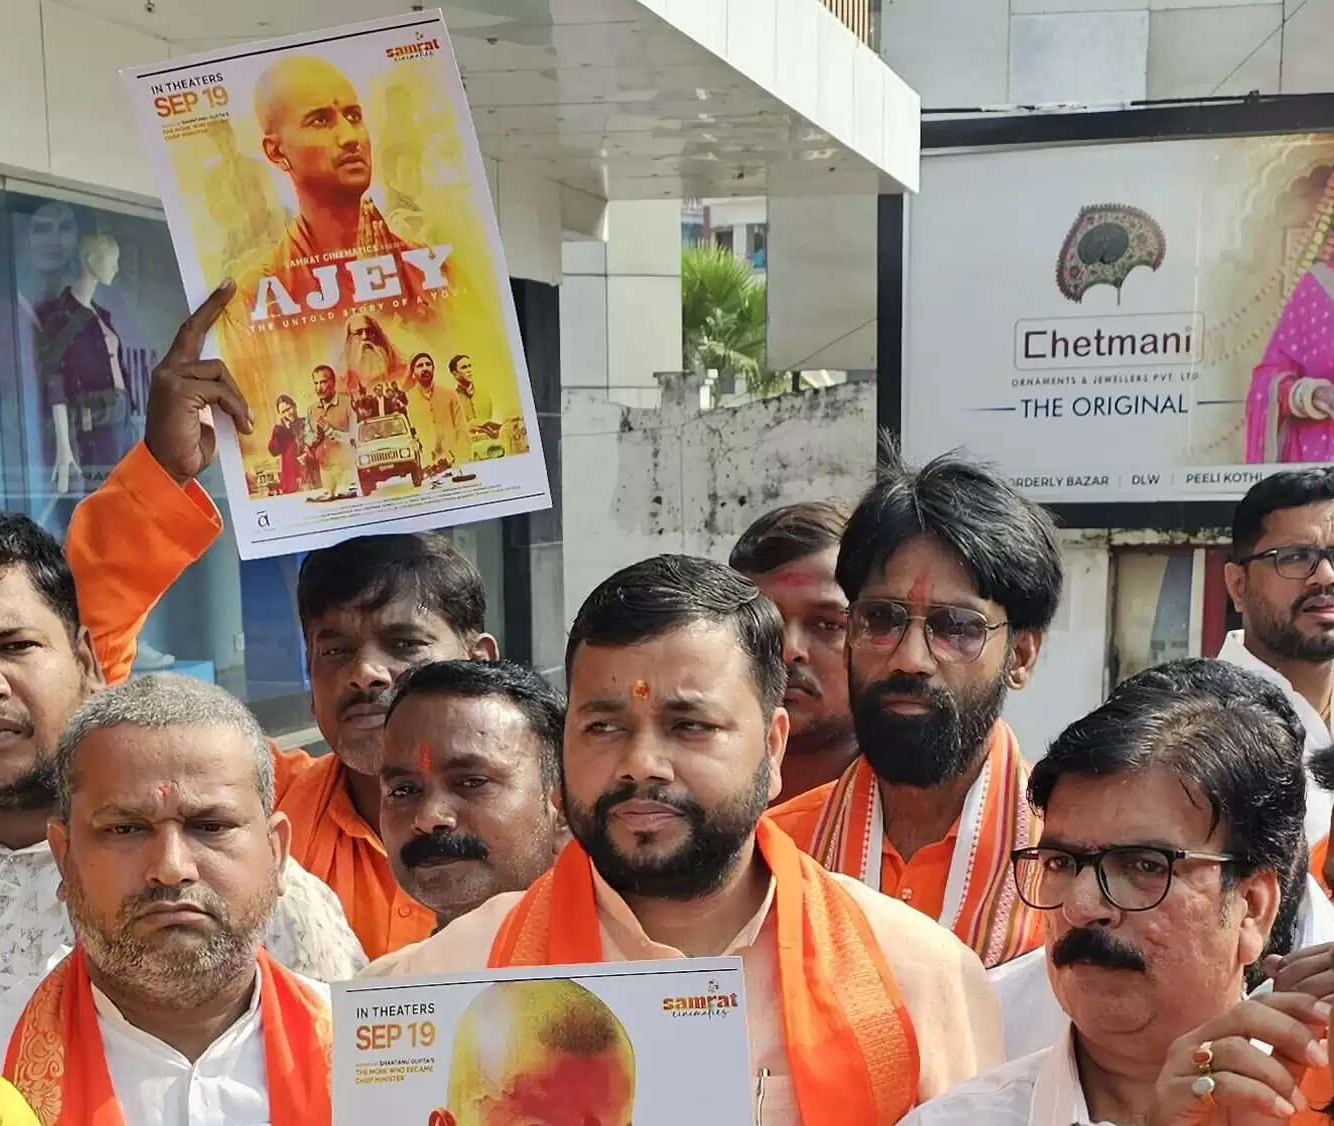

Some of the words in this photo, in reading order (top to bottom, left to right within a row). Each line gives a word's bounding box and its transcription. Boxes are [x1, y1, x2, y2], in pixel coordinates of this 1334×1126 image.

[386, 38, 440, 57] samrat
[151, 85, 163, 95] IN
[165, 73, 224, 92] THEATERS
[154, 91, 198, 118] SEP
[202, 85, 229, 108] 19
[323, 245, 378, 262] CINEMATICS
[251, 244, 453, 321] AJEY
[249, 322, 275, 334] THE
[283, 312, 335, 328] UNTOLD
[343, 302, 384, 317] STORY
[392, 298, 408, 308] OF
[417, 295, 423, 303] A
[1024, 326, 1192, 359] Chetmani
[1021, 397, 1063, 419] THE
[1072, 393, 1189, 417] ORIGINAL
[1066, 475, 1109, 487] BAZAR
[1131, 474, 1160, 485] DLW
[1186, 473, 1220, 484] PEELI
[1223, 472, 1265, 483] KOTHI
[356, 1007, 368, 1019] IN
[372, 1003, 435, 1017] THEATERS
[662, 992, 738, 1010] samrat
[356, 1023, 402, 1051] SEP
[407, 1020, 436, 1047] 19
